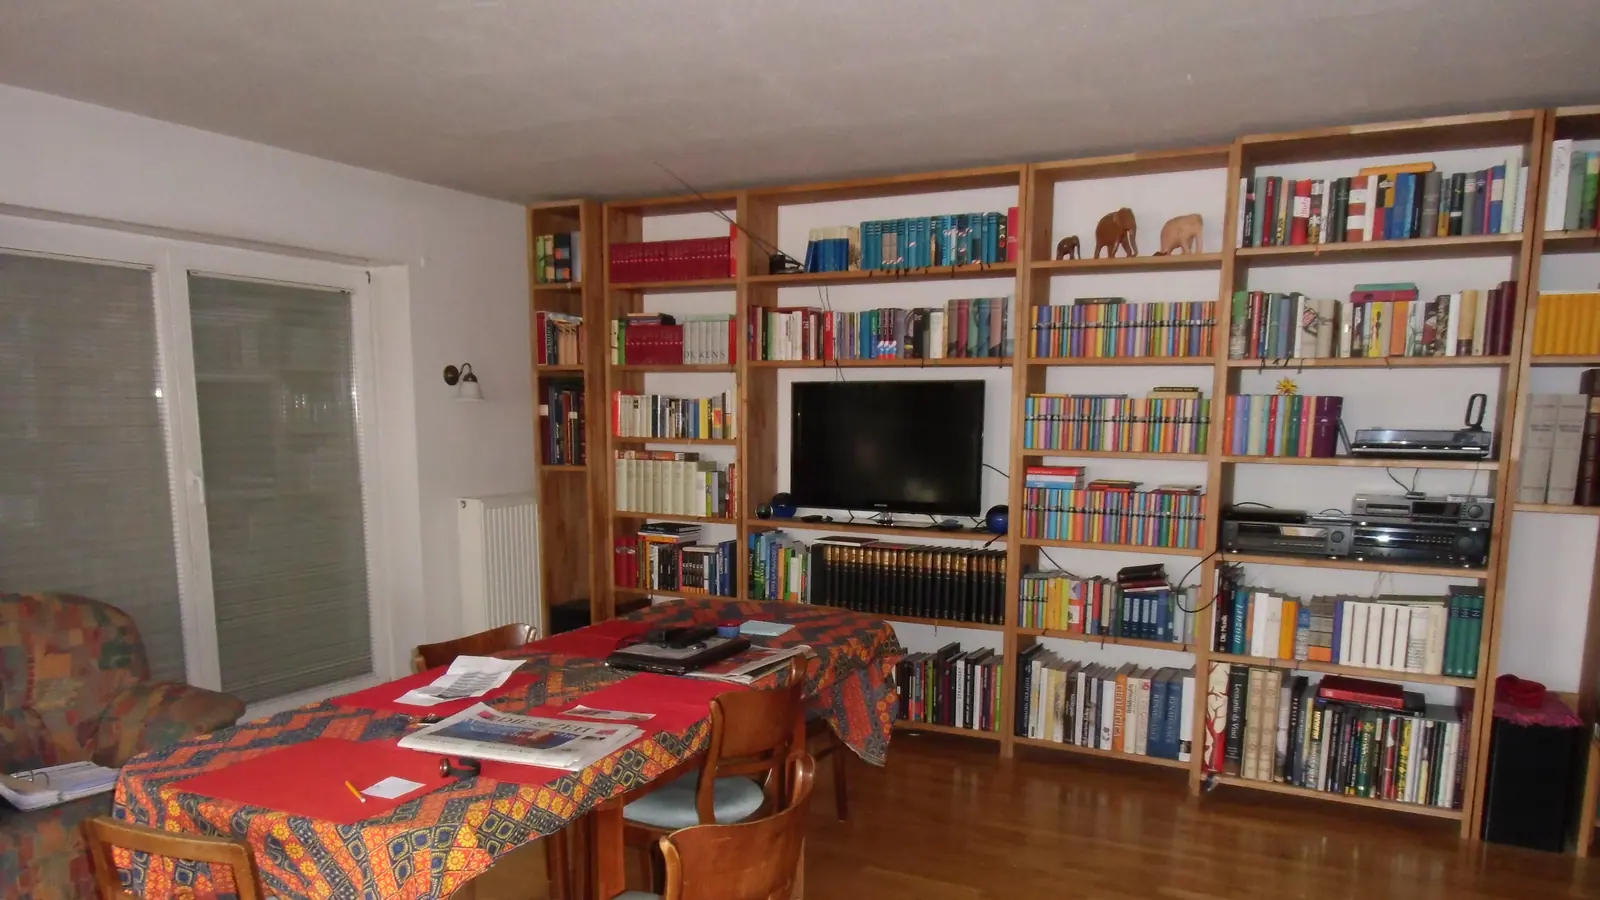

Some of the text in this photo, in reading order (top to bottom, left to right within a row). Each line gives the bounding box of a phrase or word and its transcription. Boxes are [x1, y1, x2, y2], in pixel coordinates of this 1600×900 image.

[1232, 683, 1242, 712] Leonardo
[497, 715, 528, 726] DIE
[554, 723, 593, 735] ZEIT
[1231, 713, 1240, 721] da
[1230, 723, 1240, 739] Vinci
